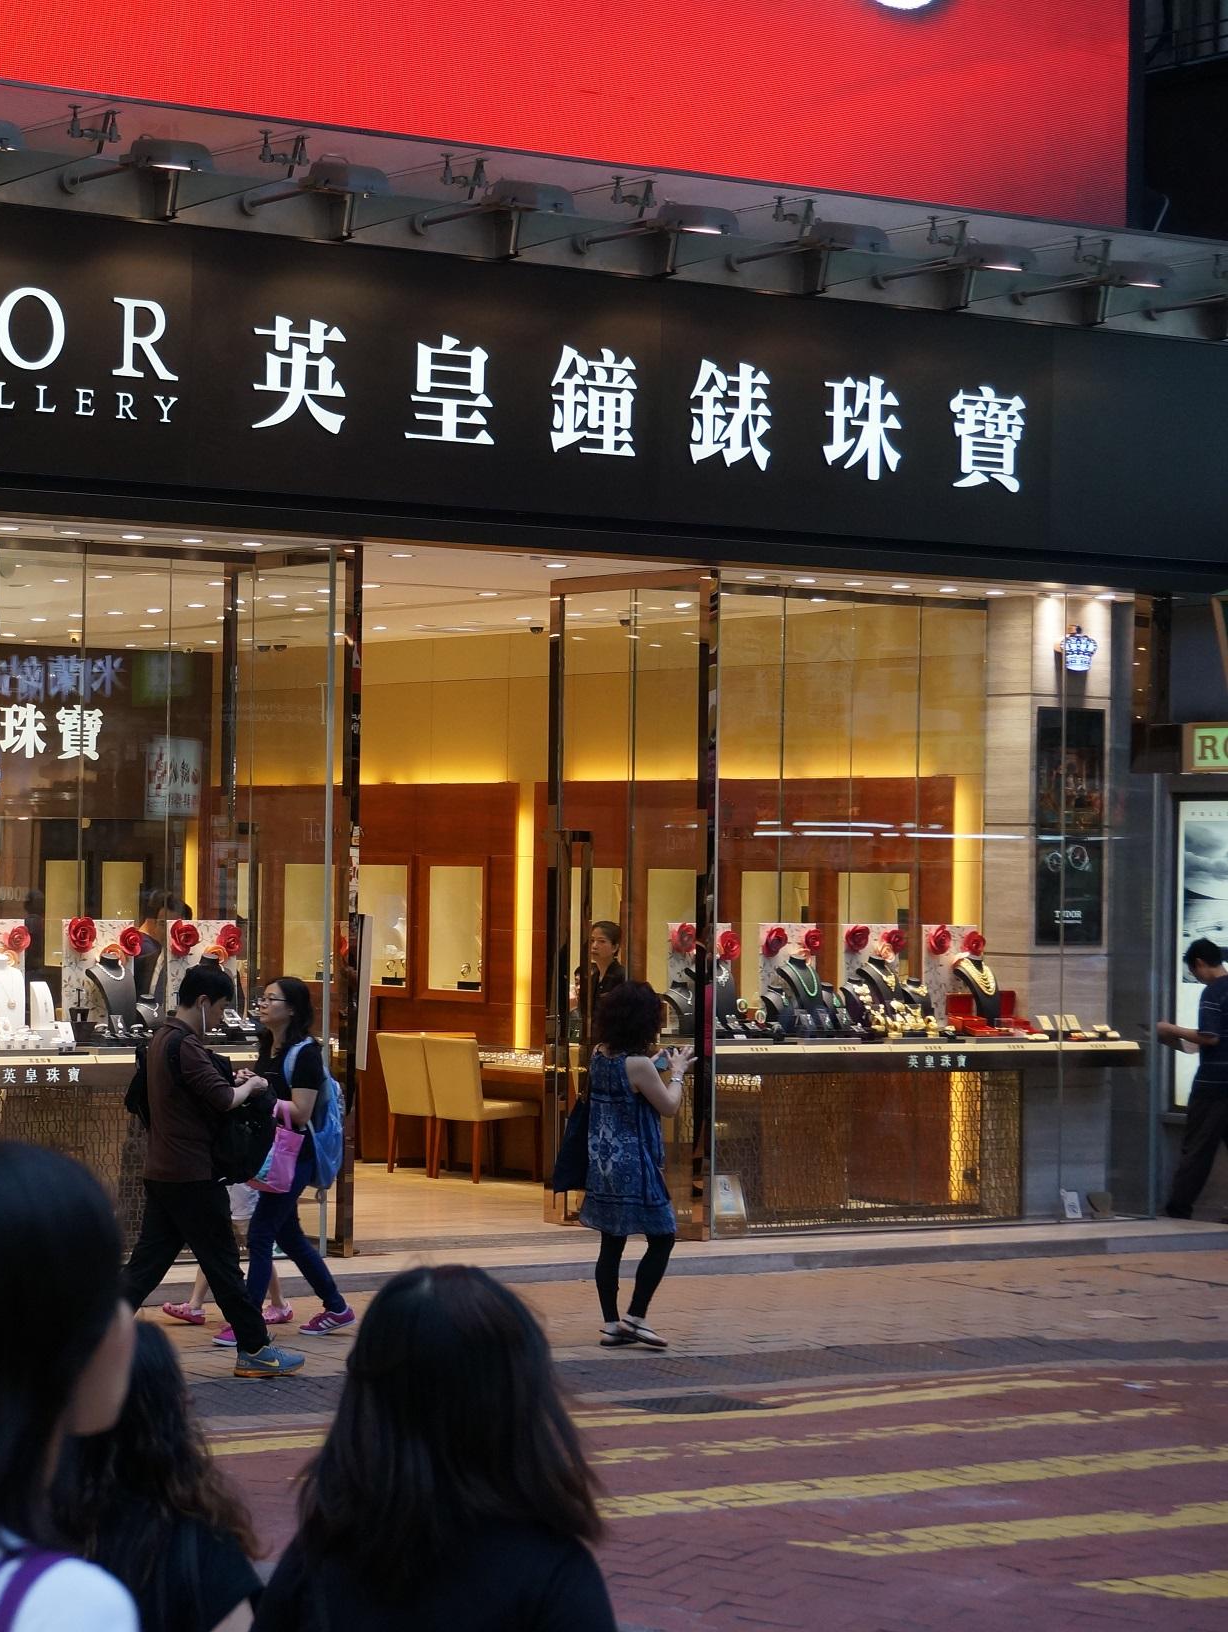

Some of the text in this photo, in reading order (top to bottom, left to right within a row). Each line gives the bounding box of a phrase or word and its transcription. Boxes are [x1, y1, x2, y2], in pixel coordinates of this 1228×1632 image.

[251, 315, 1027, 493] 英皇鐘錶珠寶
[907, 1054, 967, 1068] 英皇珠寶
[2, 1066, 81, 1083] 英皇珠寶
